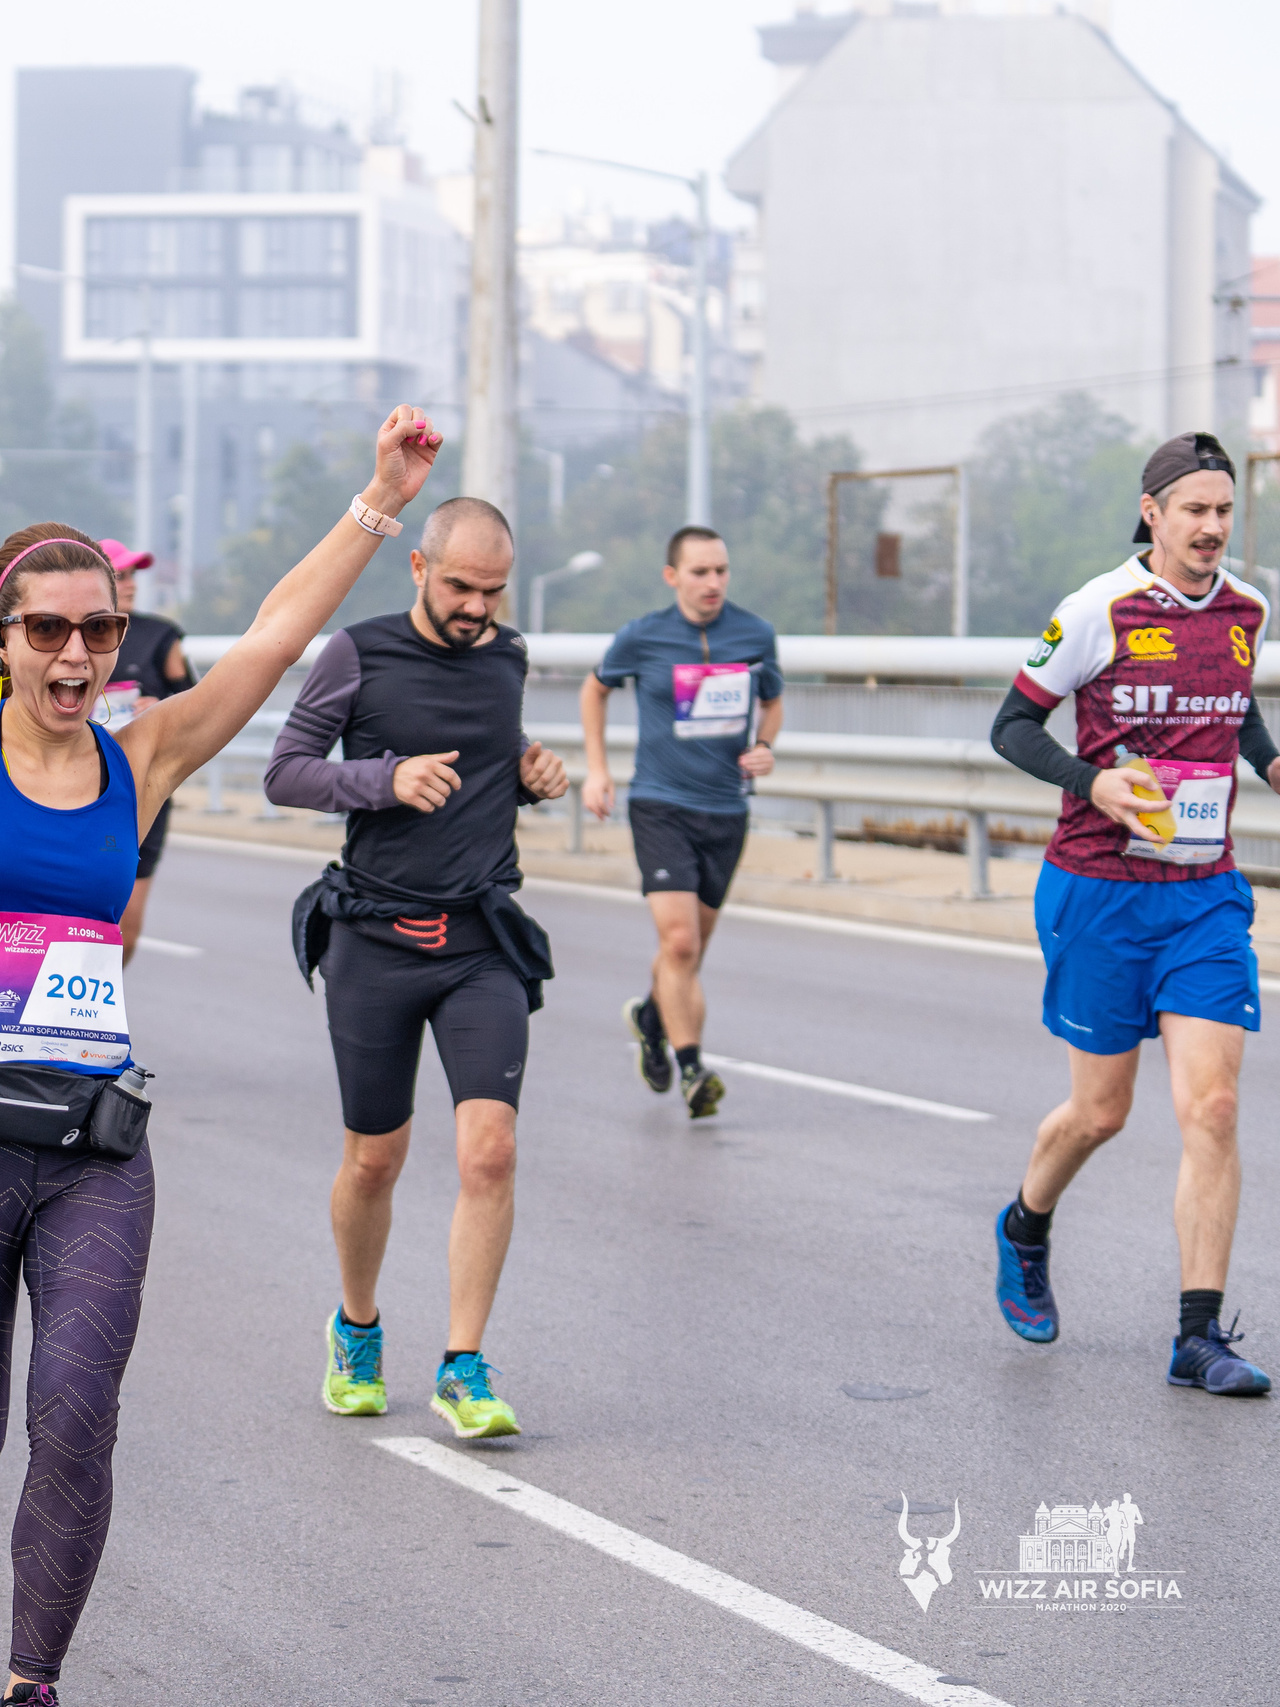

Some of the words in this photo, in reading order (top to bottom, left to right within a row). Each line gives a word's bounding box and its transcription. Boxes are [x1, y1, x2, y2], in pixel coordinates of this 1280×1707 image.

[1111, 685, 1173, 712] SIT
[1179, 802, 1218, 819] 1686
[68, 926, 96, 939] 21.098
[4, 945, 46, 954] wizzair.com
[46, 973, 116, 1006] 2072
[70, 1007, 99, 1018] FANY
[1, 1024, 21, 1033] WIZZ
[22, 1025, 35, 1034] AIR
[36, 1027, 58, 1036] SOFIA
[60, 1029, 100, 1040] MARATHON
[100, 1033, 117, 1041] 2020
